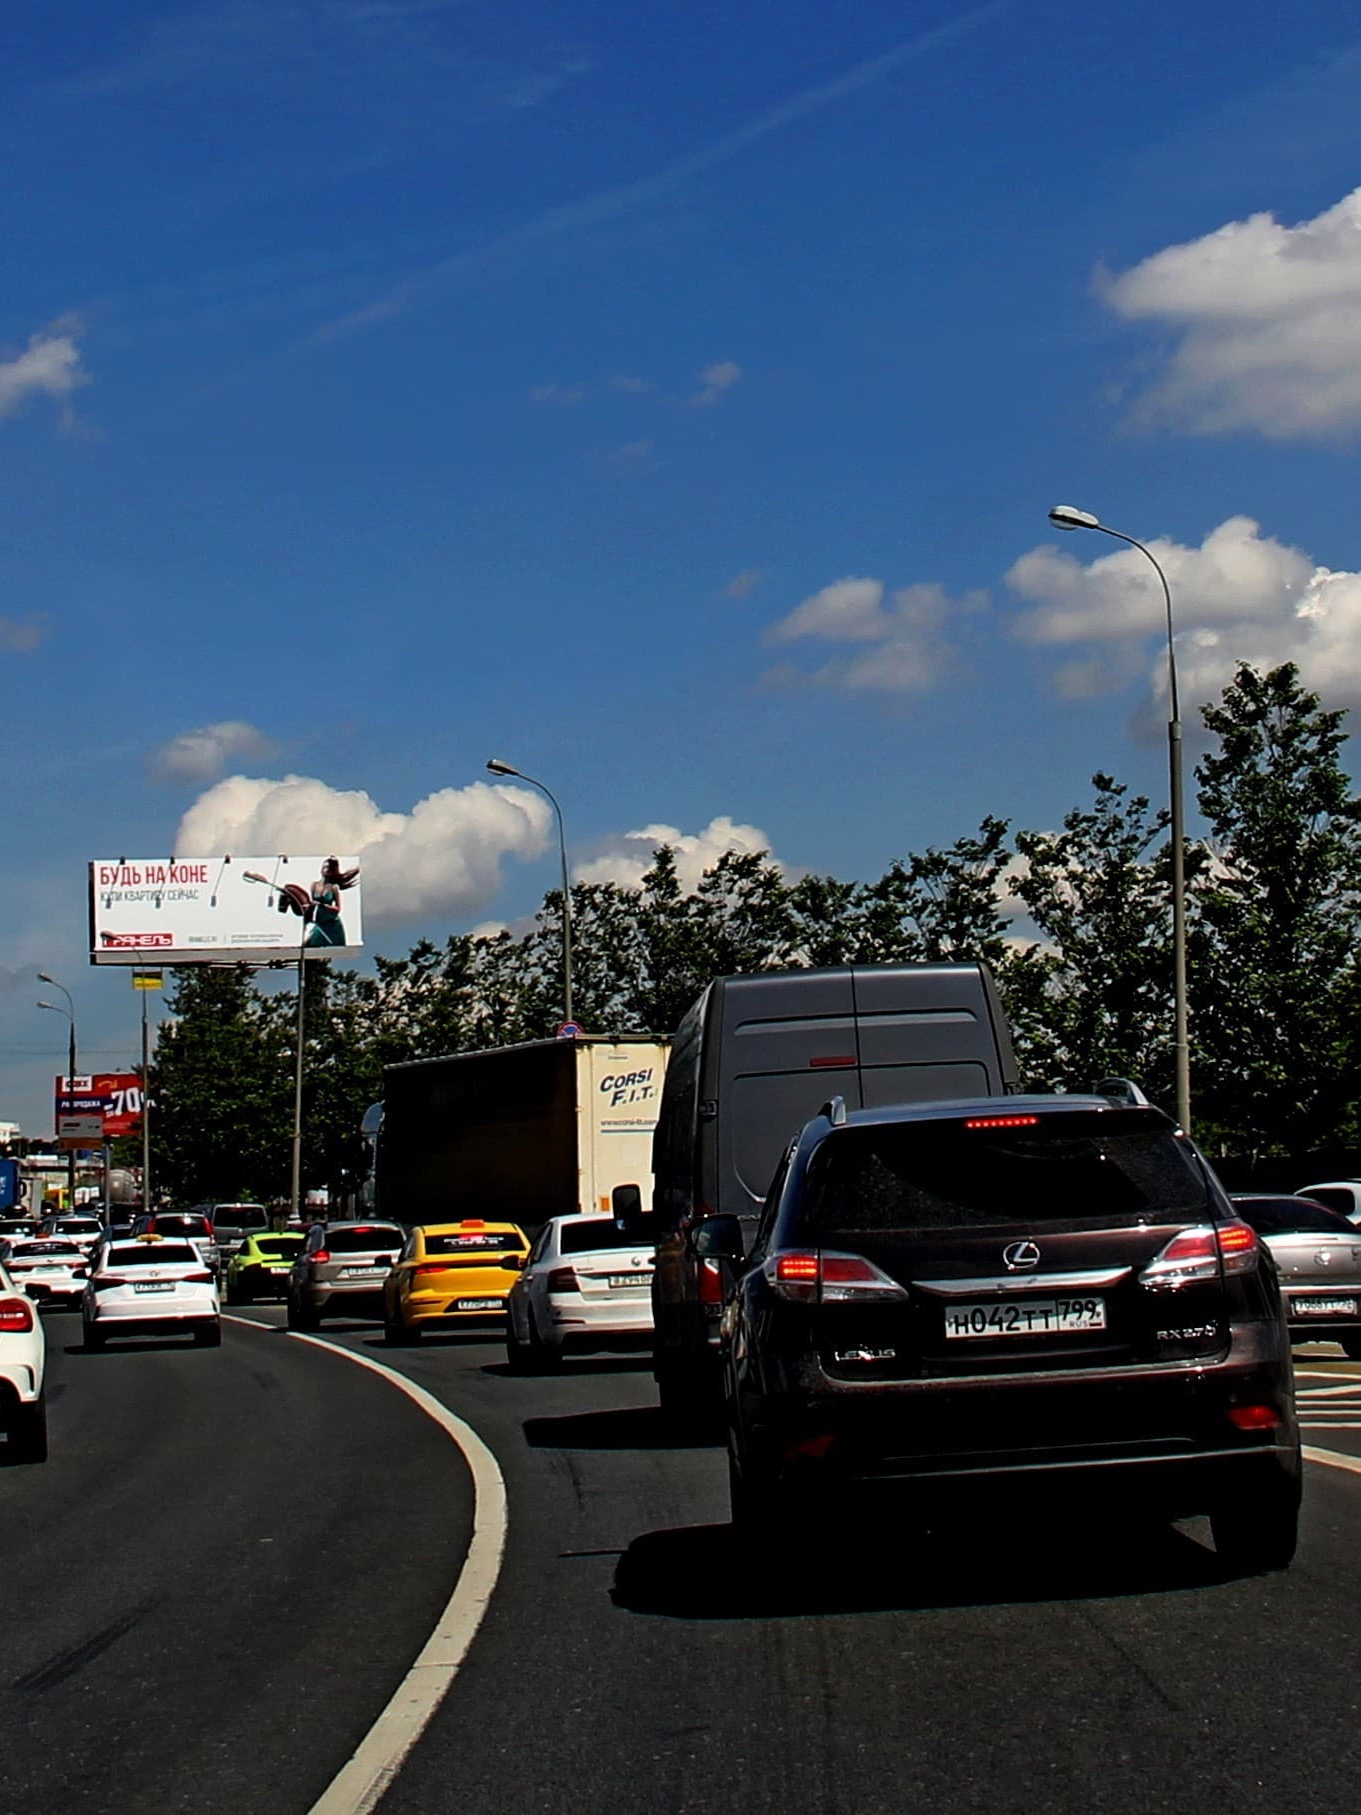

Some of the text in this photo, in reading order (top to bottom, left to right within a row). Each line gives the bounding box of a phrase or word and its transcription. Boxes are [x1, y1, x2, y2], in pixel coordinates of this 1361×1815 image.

[100, 865, 208, 886] БУДЬ НА КОНЕ
[600, 1068, 653, 1092] CORSI
[610, 1085, 654, 1107] F.I.T.
[1059, 1301, 1097, 1321] 799
[1157, 1329, 1182, 1340] RX
